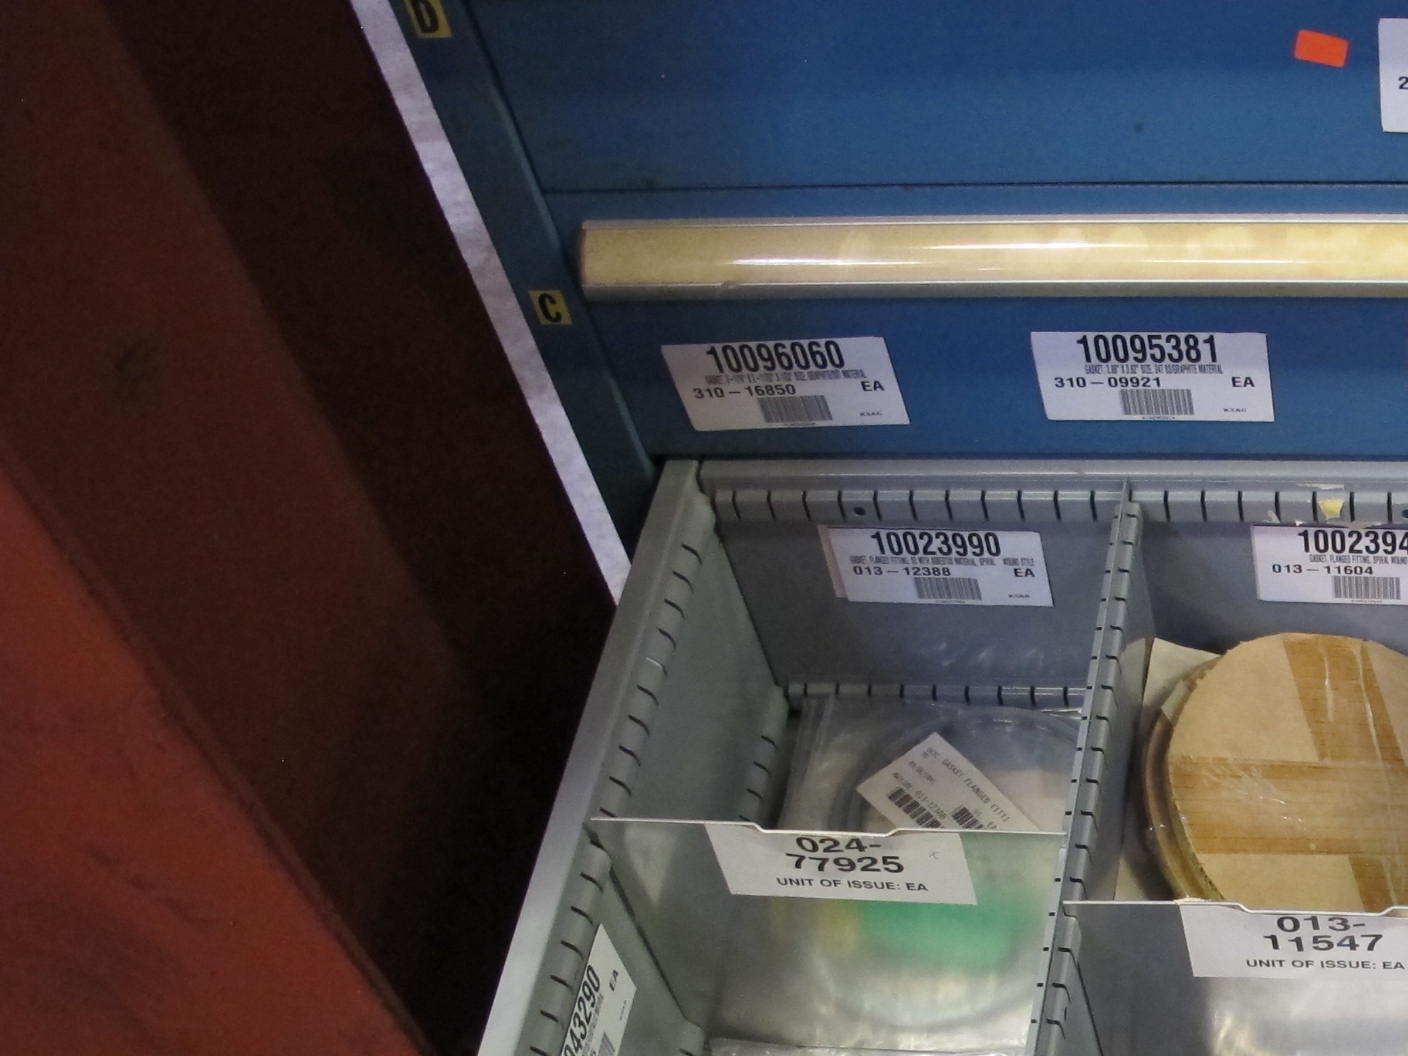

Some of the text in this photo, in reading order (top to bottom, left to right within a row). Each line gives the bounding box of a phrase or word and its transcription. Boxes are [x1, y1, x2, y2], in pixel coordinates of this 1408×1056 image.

[538, 293, 562, 322] C
[707, 340, 845, 373] 10096060
[1077, 335, 1218, 363] 10095381
[862, 380, 885, 392] EA
[1232, 377, 1255, 387] EA
[871, 531, 1001, 556] 10023990
[1014, 568, 1035, 577] EA
[797, 837, 881, 852] 024-
[786, 854, 904, 873] 77925
[777, 877, 813, 887] UNIT
[820, 878, 842, 888] OF
[906, 883, 928, 892] EA
[1277, 916, 1366, 932] 013-
[1264, 934, 1383, 952] 11547
[1246, 959, 1285, 968] UNIT
[1291, 960, 1314, 968] OF
[1382, 962, 1406, 970] EA
[609, 968, 619, 992] EA
